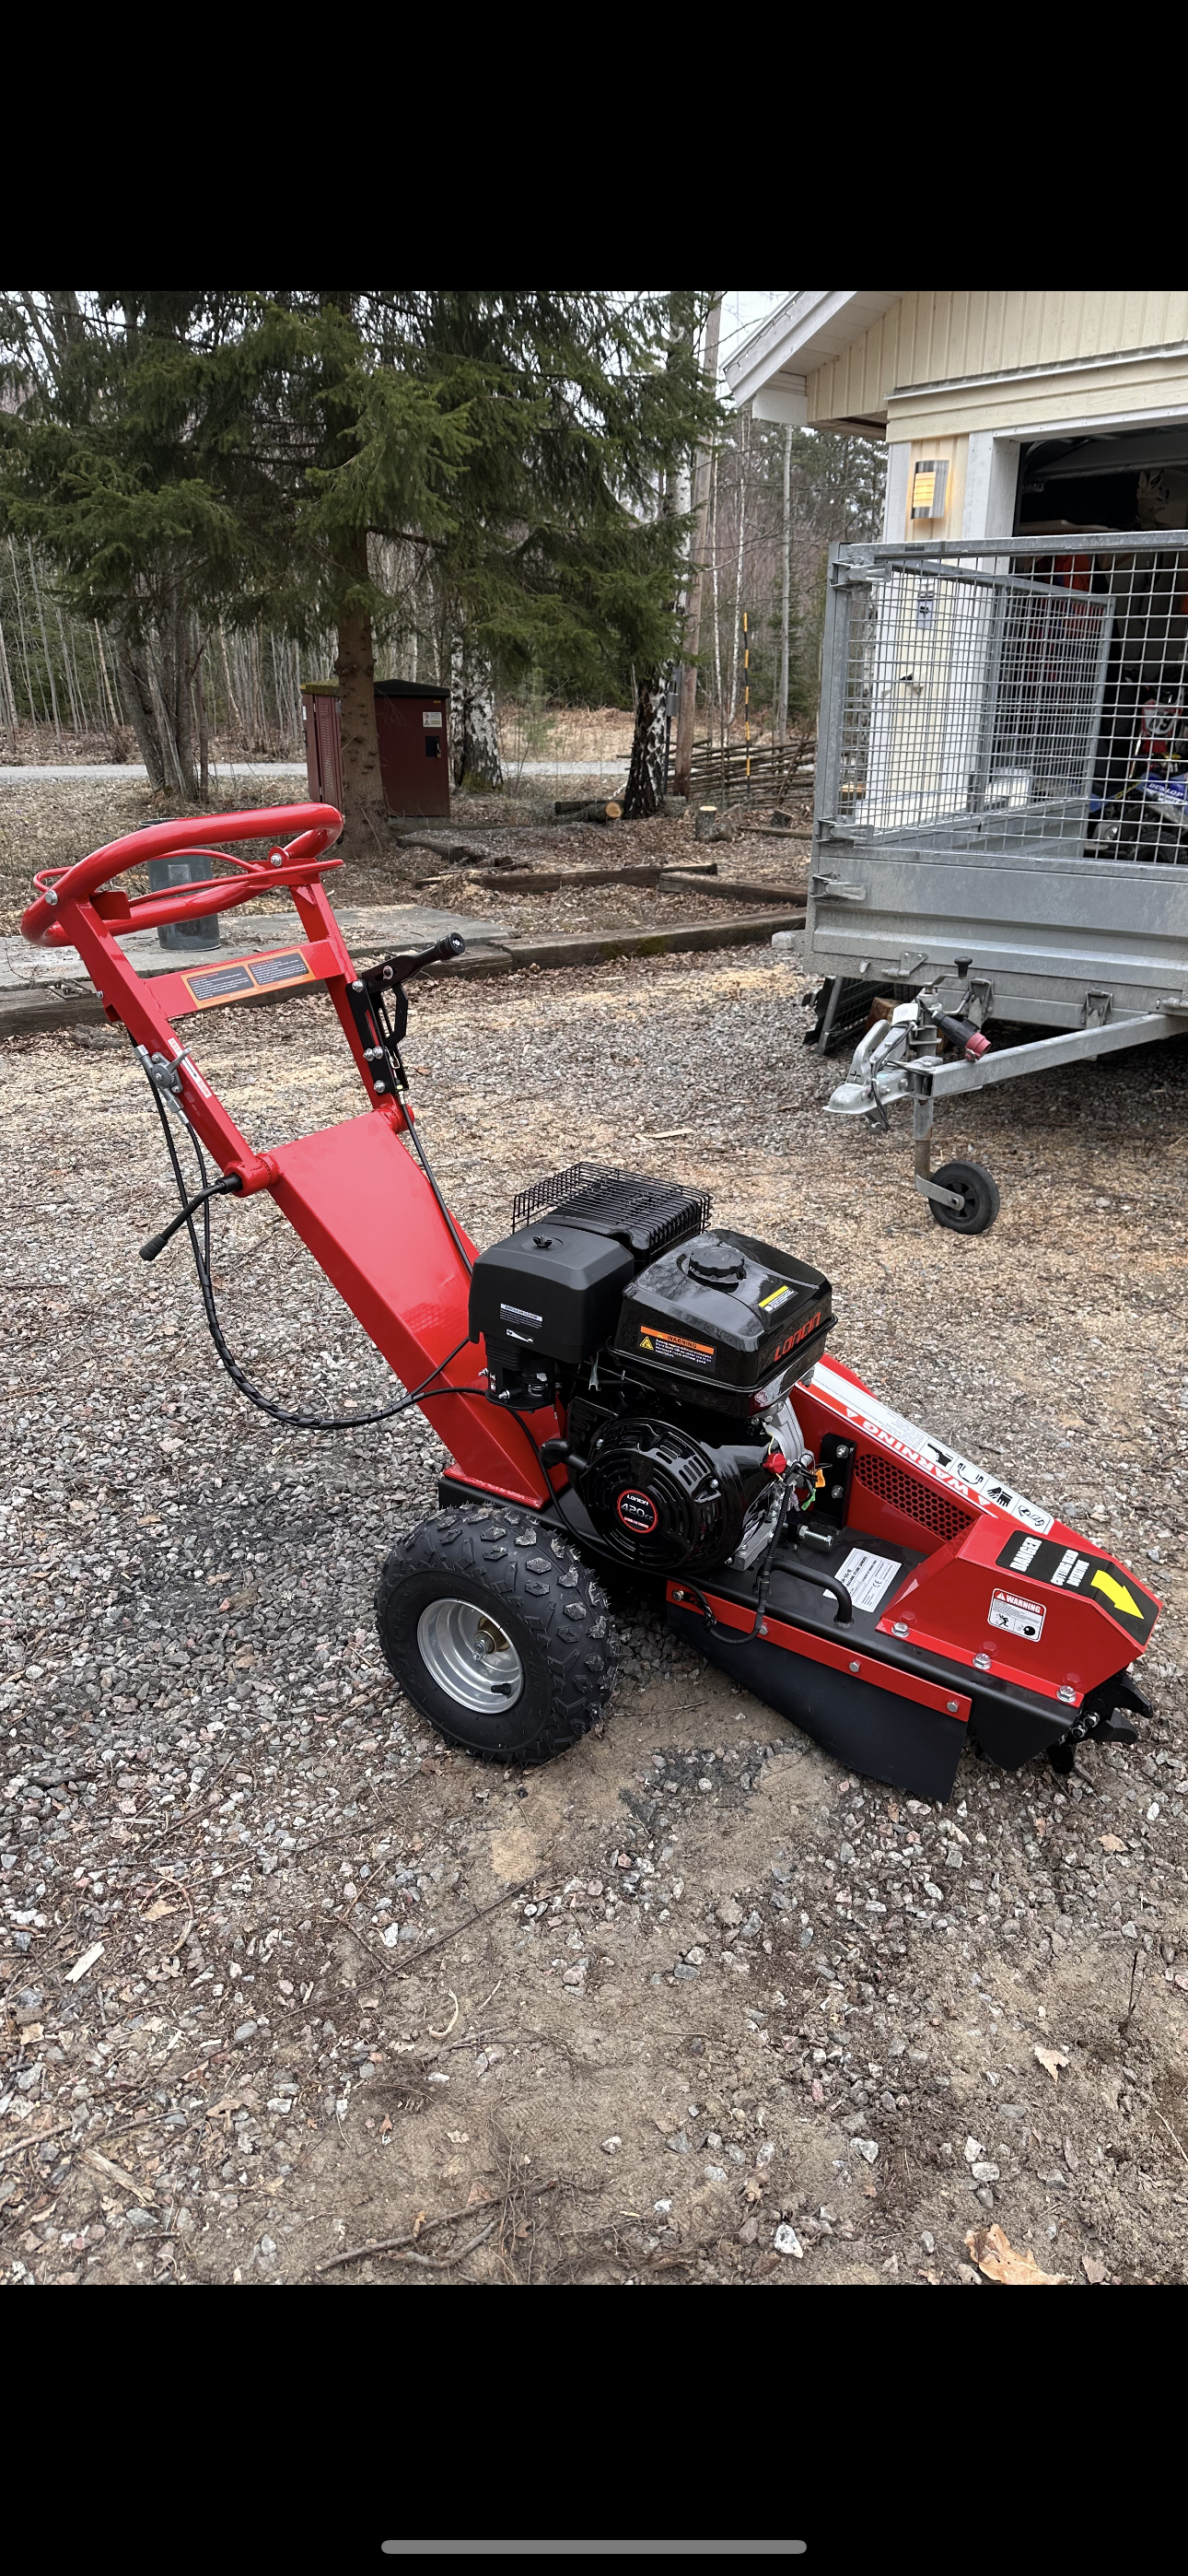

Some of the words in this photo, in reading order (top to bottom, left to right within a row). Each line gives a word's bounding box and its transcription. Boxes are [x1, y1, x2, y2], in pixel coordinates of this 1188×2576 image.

[1148, 783, 1183, 797] DUNLOP
[667, 1335, 697, 1349] WARNING
[862, 1421, 970, 1495] WARNING
[1009, 1537, 1042, 1572] DANGER
[1061, 1549, 1078, 1565] HEAD
[1051, 1562, 1073, 1586] CUTTING
[1066, 1559, 1089, 1587] ROTATION
[1006, 1595, 1041, 1613] WARNING
